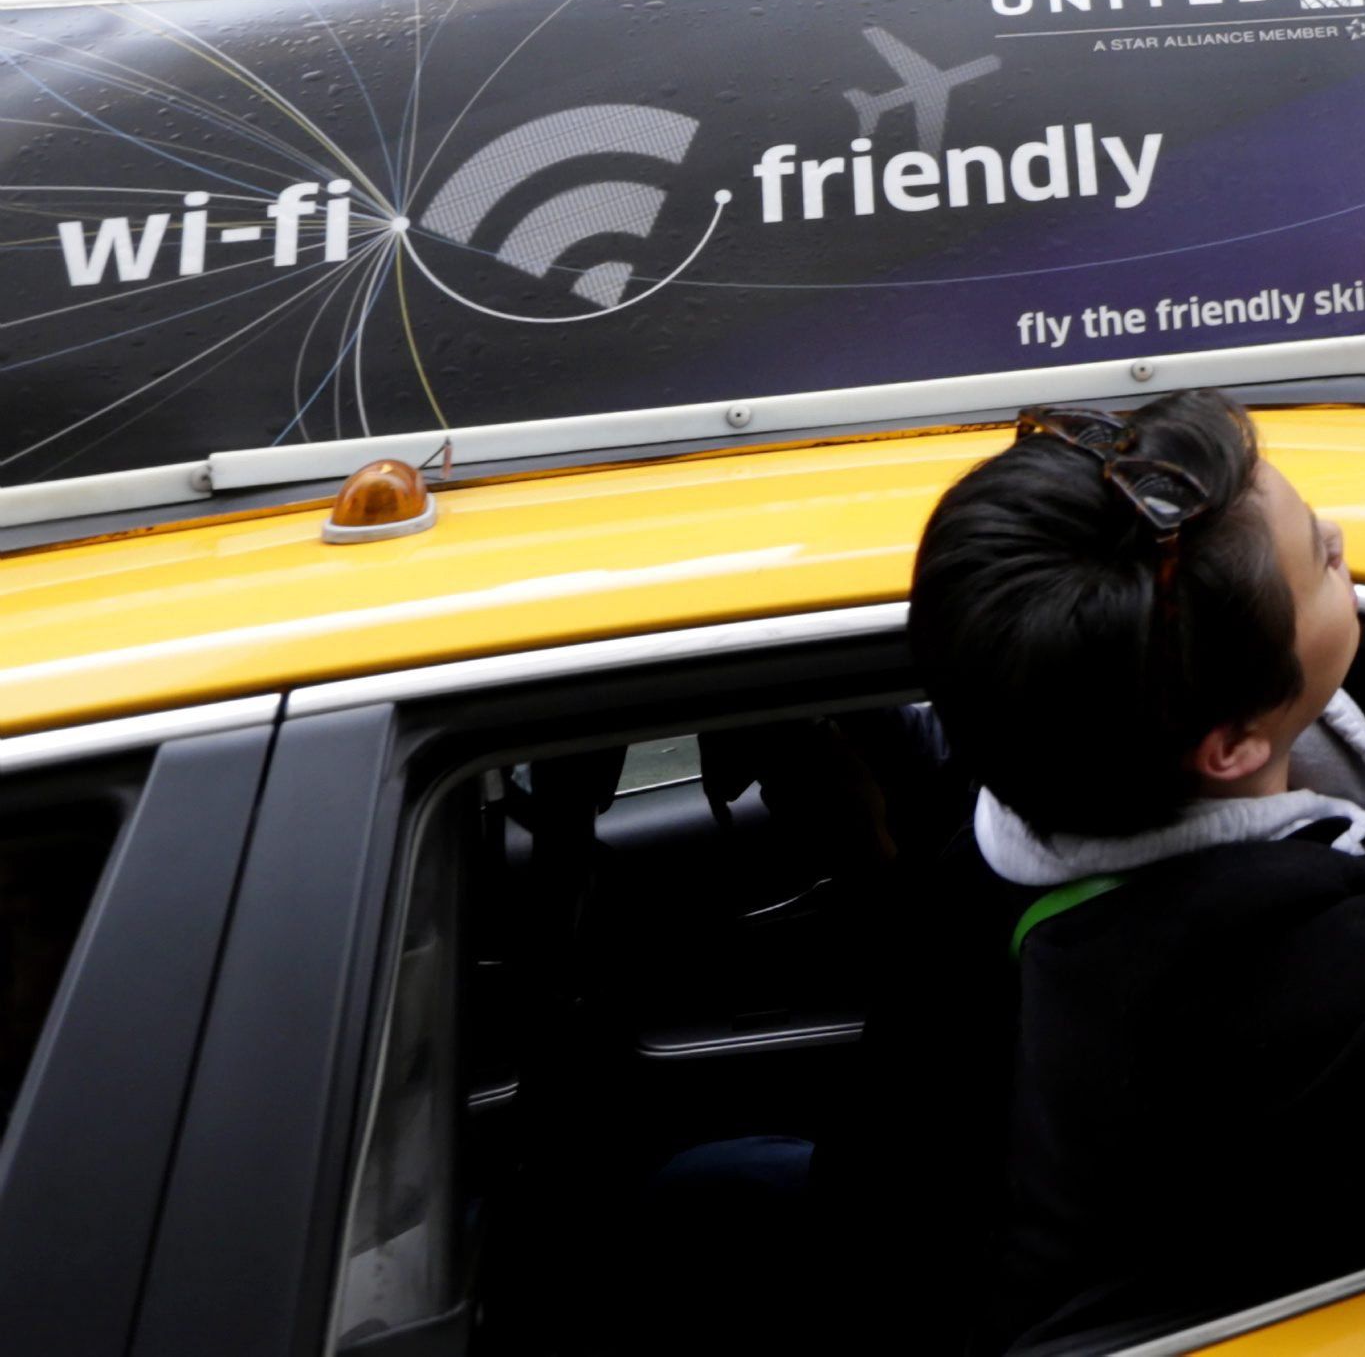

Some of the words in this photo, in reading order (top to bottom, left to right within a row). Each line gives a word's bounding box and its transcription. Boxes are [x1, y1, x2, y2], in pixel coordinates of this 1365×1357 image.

[1093, 39, 1107, 52] A
[1110, 37, 1162, 52] STAR
[1164, 31, 1256, 49] ALLIANCE
[1258, 25, 1339, 43] MEMBER
[58, 179, 352, 291] wi-fi
[753, 123, 1163, 225] friendly
[1017, 310, 1071, 348] fly
[1082, 304, 1146, 339] the
[1156, 288, 1305, 331] friendly
